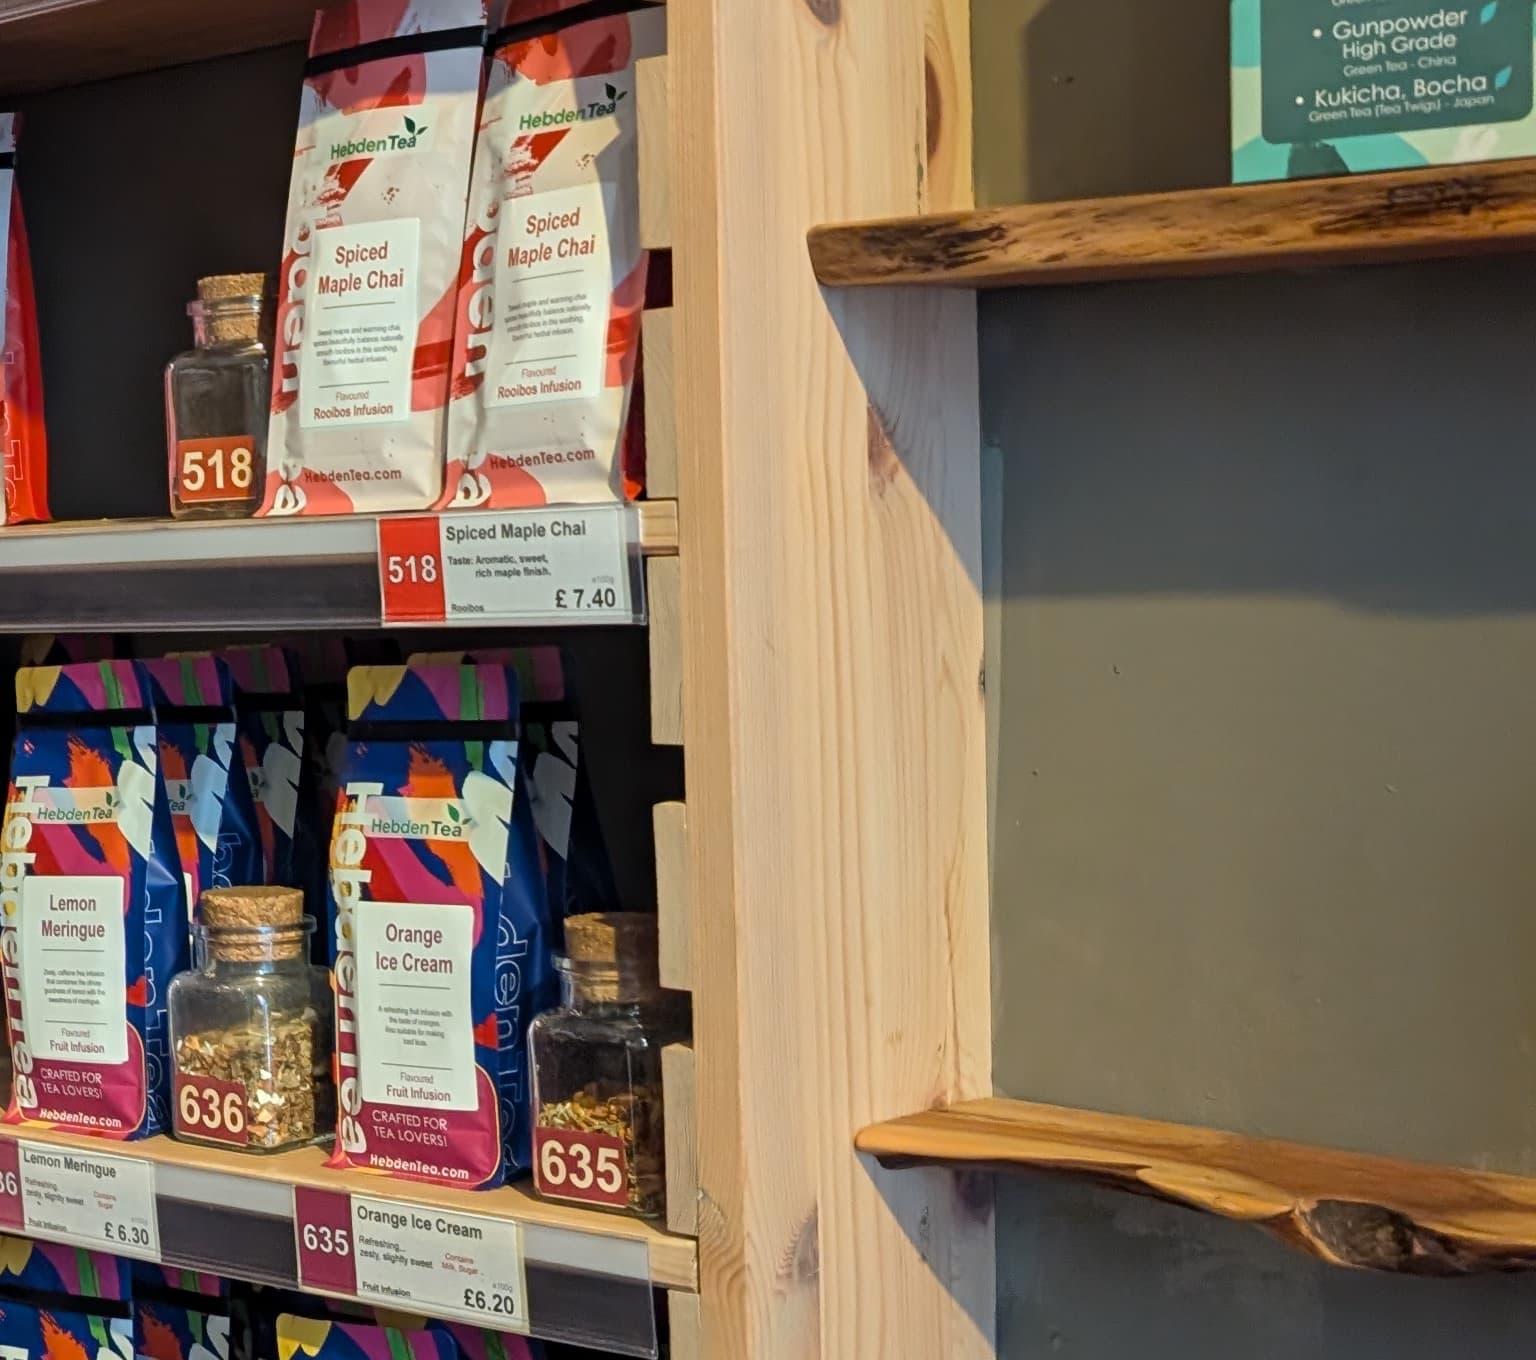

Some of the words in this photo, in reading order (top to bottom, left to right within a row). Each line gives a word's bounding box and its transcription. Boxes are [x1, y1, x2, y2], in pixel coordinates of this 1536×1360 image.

[1333, 7, 1467, 40] Gunpowder
[1342, 38, 1386, 59] High
[1391, 29, 1456, 53] Grade
[1414, 71, 1486, 96] Bocha
[335, 241, 388, 264] Spiced
[317, 271, 362, 295] Maple
[367, 268, 404, 290] Chai
[182, 447, 253, 491] 518
[489, 447, 595, 470] HebdenTea.com
[446, 524, 497, 546] Spiced
[501, 522, 546, 544] Maple
[550, 520, 586, 539] Chai
[388, 555, 437, 584] 518
[48, 893, 96, 915] Lemon
[41, 918, 105, 943] Meringue
[385, 923, 443, 949] Orange
[375, 952, 401, 973] Ice
[404, 952, 454, 977] Cream
[180, 1086, 243, 1132] 636
[539, 1140, 623, 1193] 635
[463, 1287, 514, 1315] £6.20
